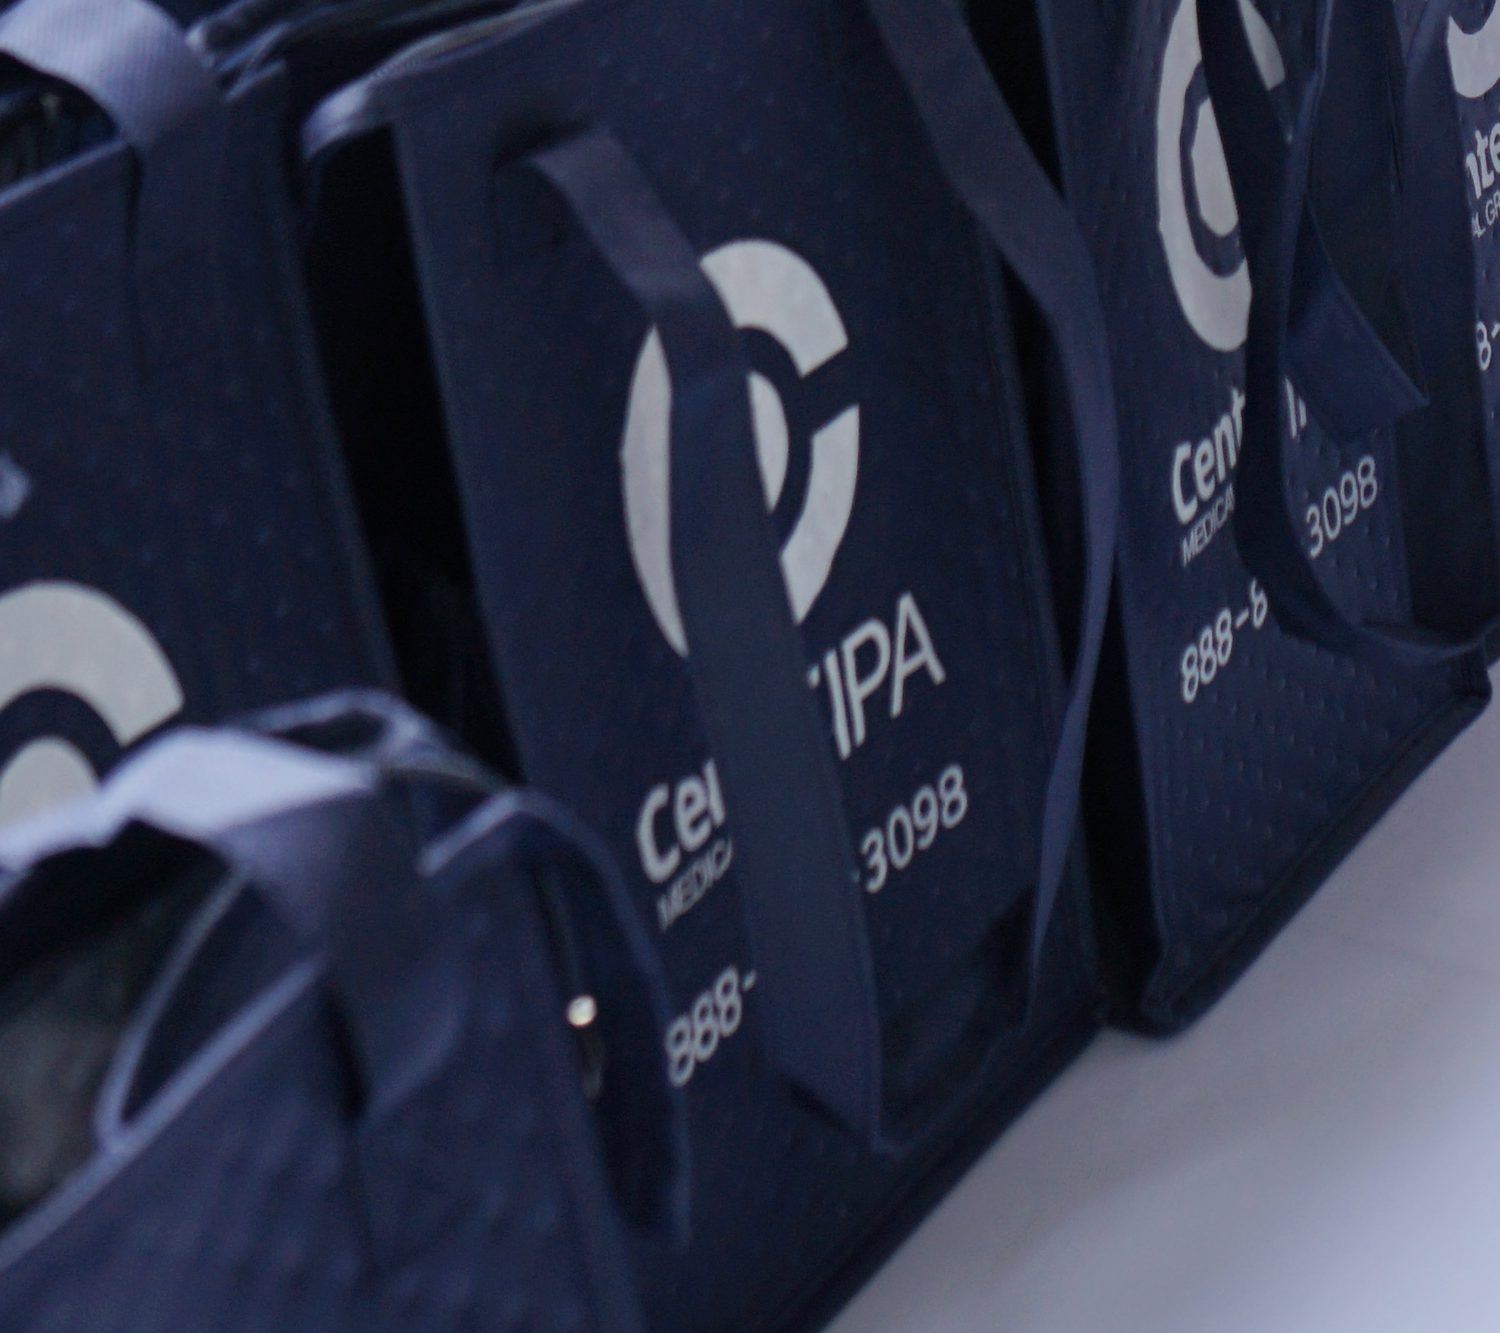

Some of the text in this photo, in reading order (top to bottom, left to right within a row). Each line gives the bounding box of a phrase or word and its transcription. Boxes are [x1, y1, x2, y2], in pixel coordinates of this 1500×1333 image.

[1171, 387, 1246, 525] Cent
[1180, 484, 1235, 567] MEDICA
[823, 591, 946, 761] IPA
[657, 835, 733, 932] MEDIC
